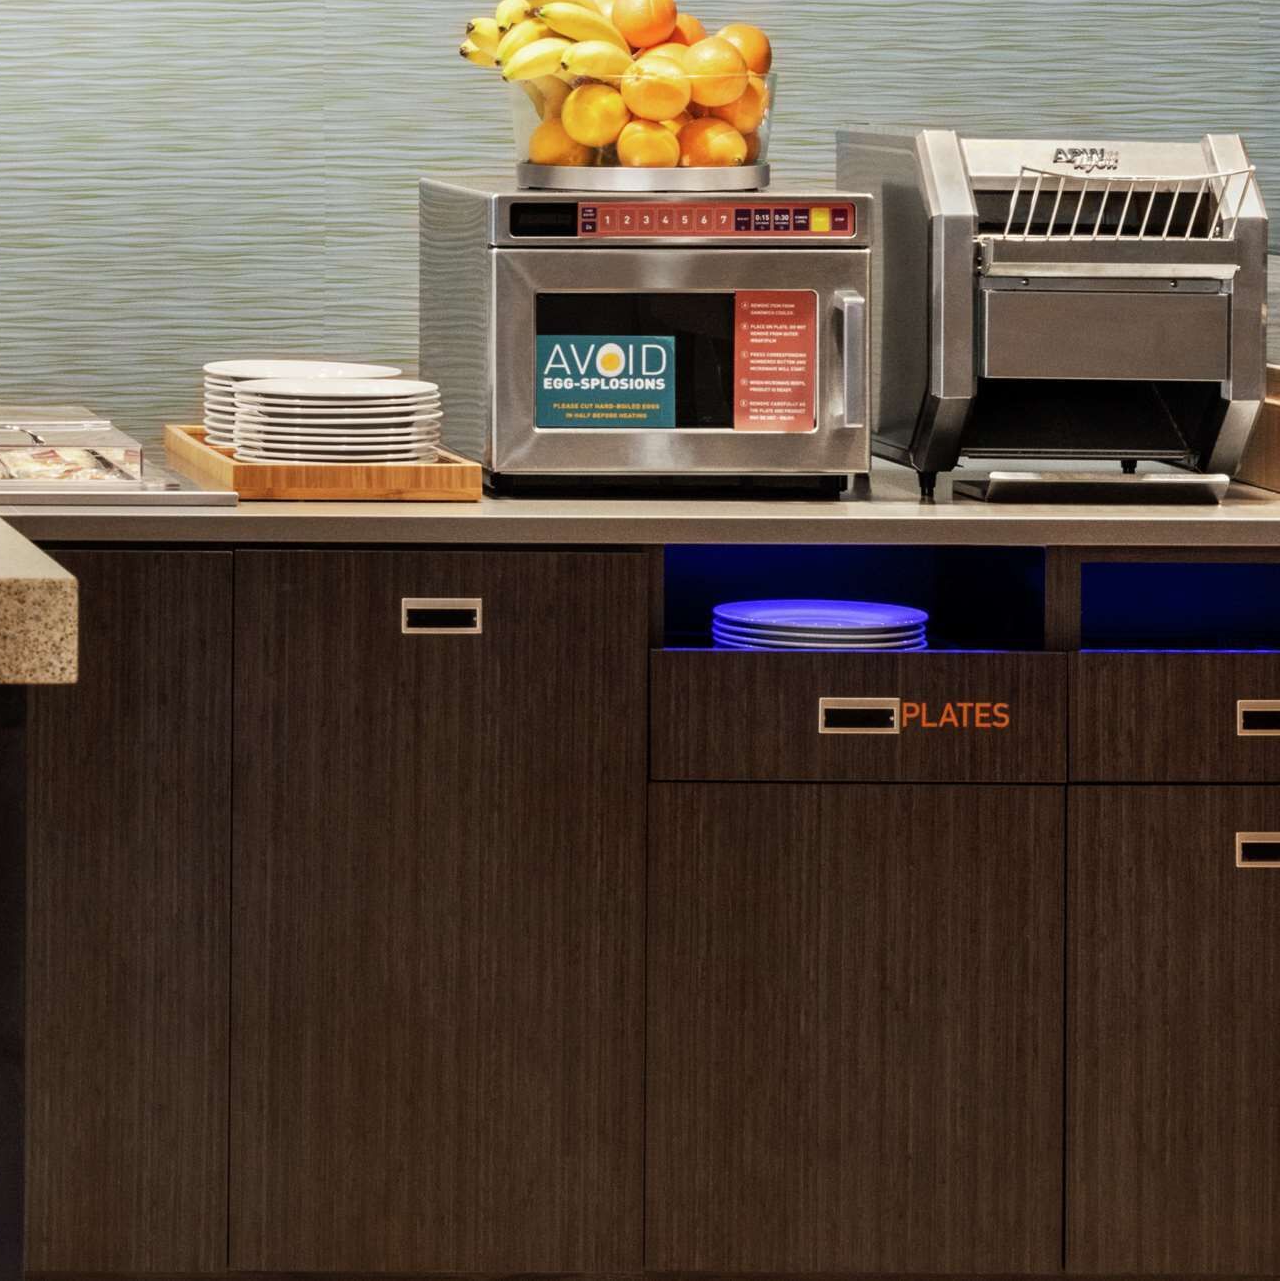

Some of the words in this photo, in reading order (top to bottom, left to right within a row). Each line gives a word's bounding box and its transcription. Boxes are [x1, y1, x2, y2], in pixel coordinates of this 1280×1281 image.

[543, 342, 667, 378] AVOID
[543, 378, 666, 390] EGG-SPLOSIONS
[902, 702, 1010, 728] PLATES
